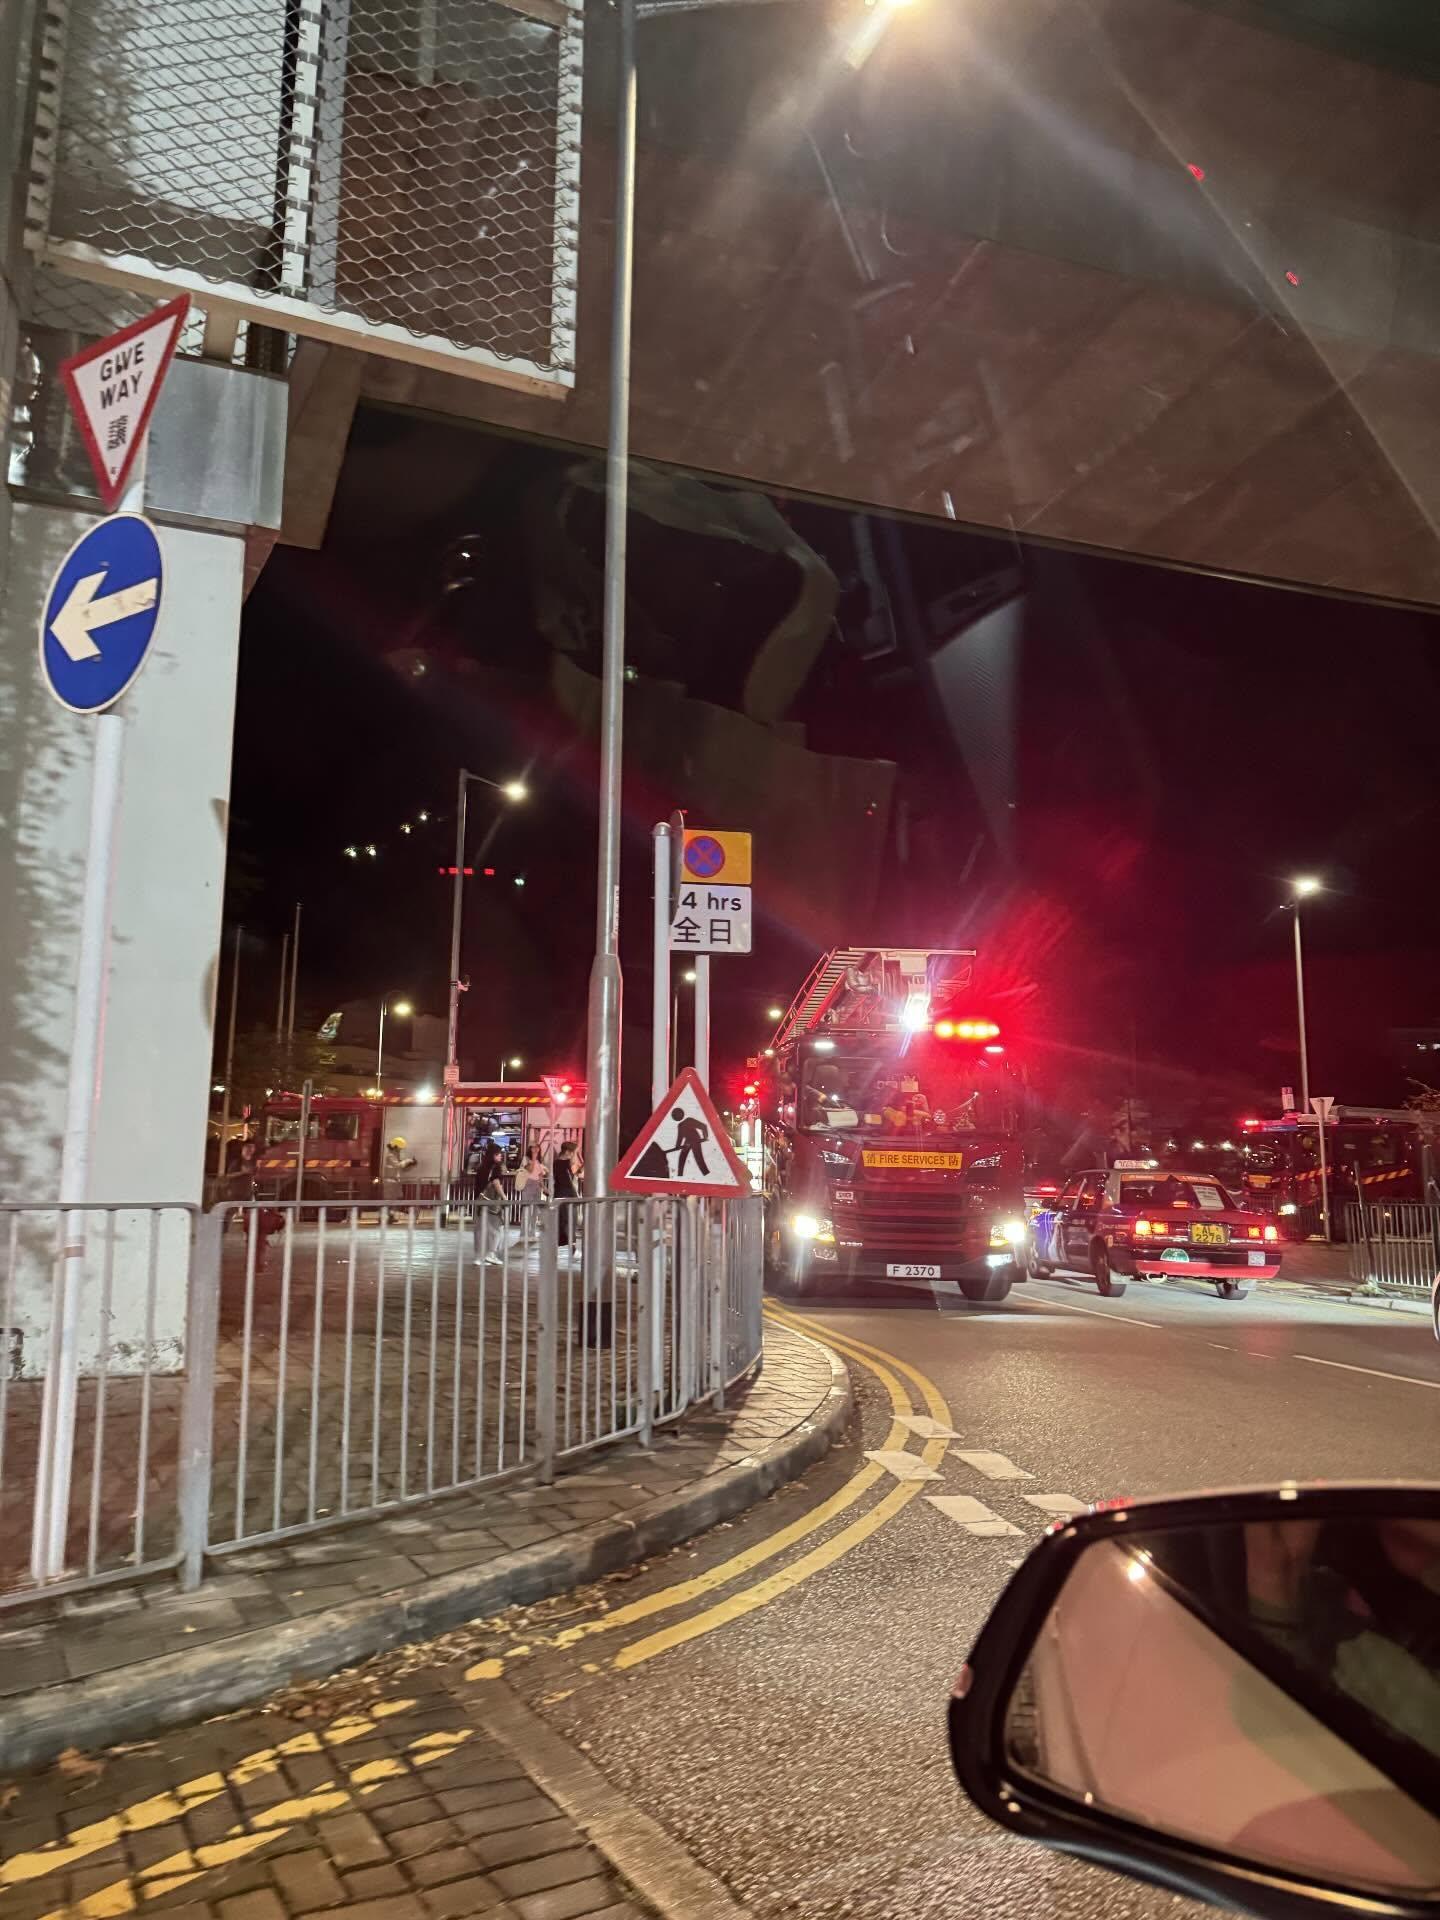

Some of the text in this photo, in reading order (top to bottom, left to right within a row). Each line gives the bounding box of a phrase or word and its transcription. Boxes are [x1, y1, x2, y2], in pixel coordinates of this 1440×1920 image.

[100, 341, 145, 382] GIVE
[100, 371, 143, 410] WAY
[707, 892, 742, 911] hrs
[673, 916, 731, 945] 全日
[879, 1154, 900, 1164] FIRE
[902, 1154, 945, 1165] SERVICES
[1195, 1233, 1222, 1243] 2278
[892, 1265, 935, 1277] F 2370
